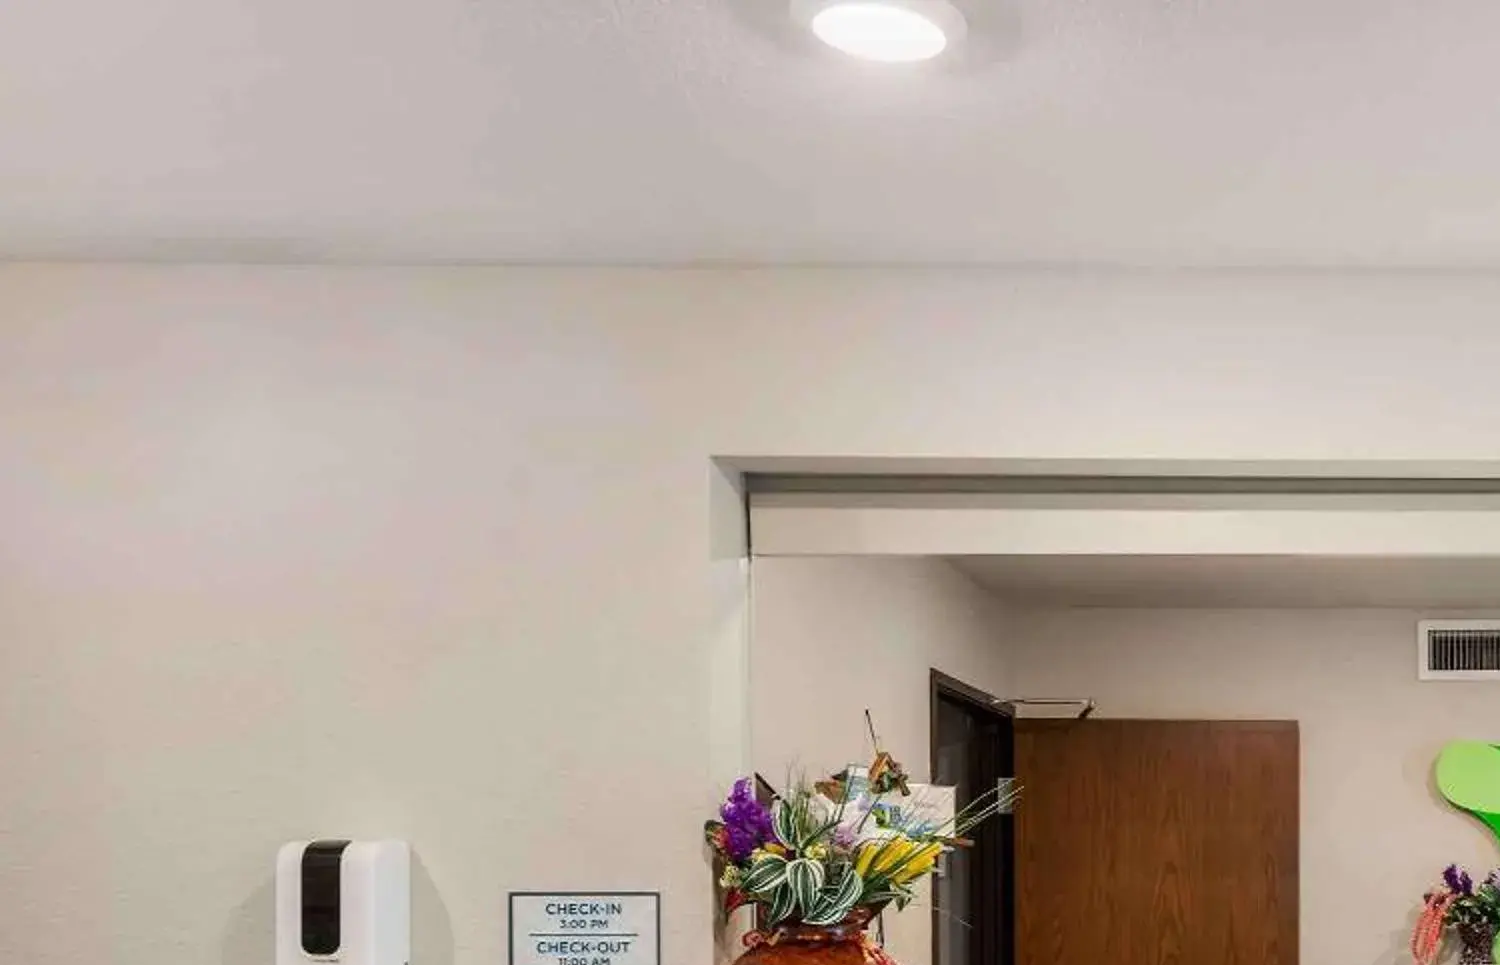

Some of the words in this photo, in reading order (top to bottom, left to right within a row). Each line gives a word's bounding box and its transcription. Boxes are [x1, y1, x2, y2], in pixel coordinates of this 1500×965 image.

[545, 903, 622, 915] CHECK-IN
[559, 919, 587, 929] 3:00
[590, 919, 609, 929] PM
[536, 941, 631, 954] CHECK-OUT
